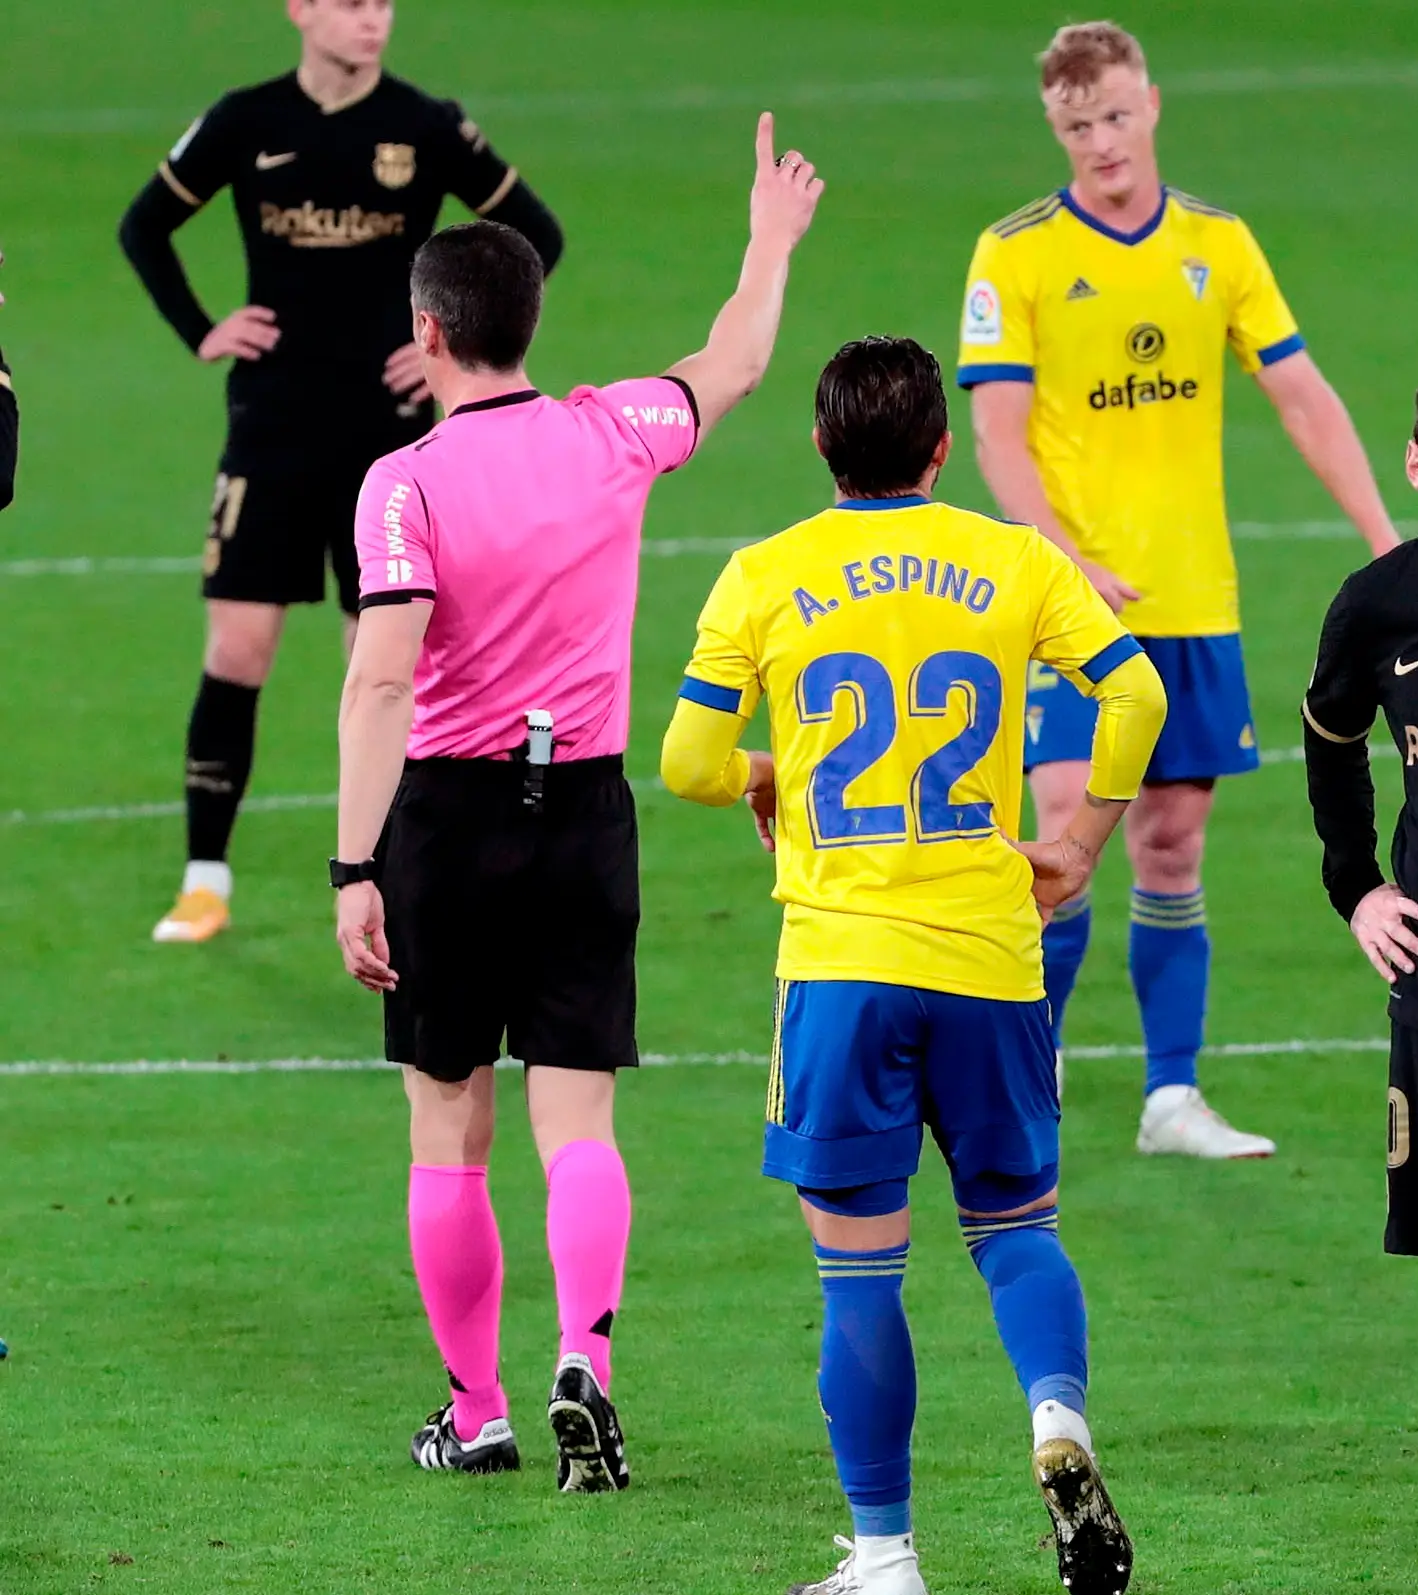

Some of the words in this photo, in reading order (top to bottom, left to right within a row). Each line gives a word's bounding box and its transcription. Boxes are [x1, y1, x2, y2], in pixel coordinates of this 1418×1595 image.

[792, 587, 839, 626] A.
[842, 555, 996, 614] ESPINO
[795, 651, 1003, 849] 22
[483, 1427, 509, 1439] adida
